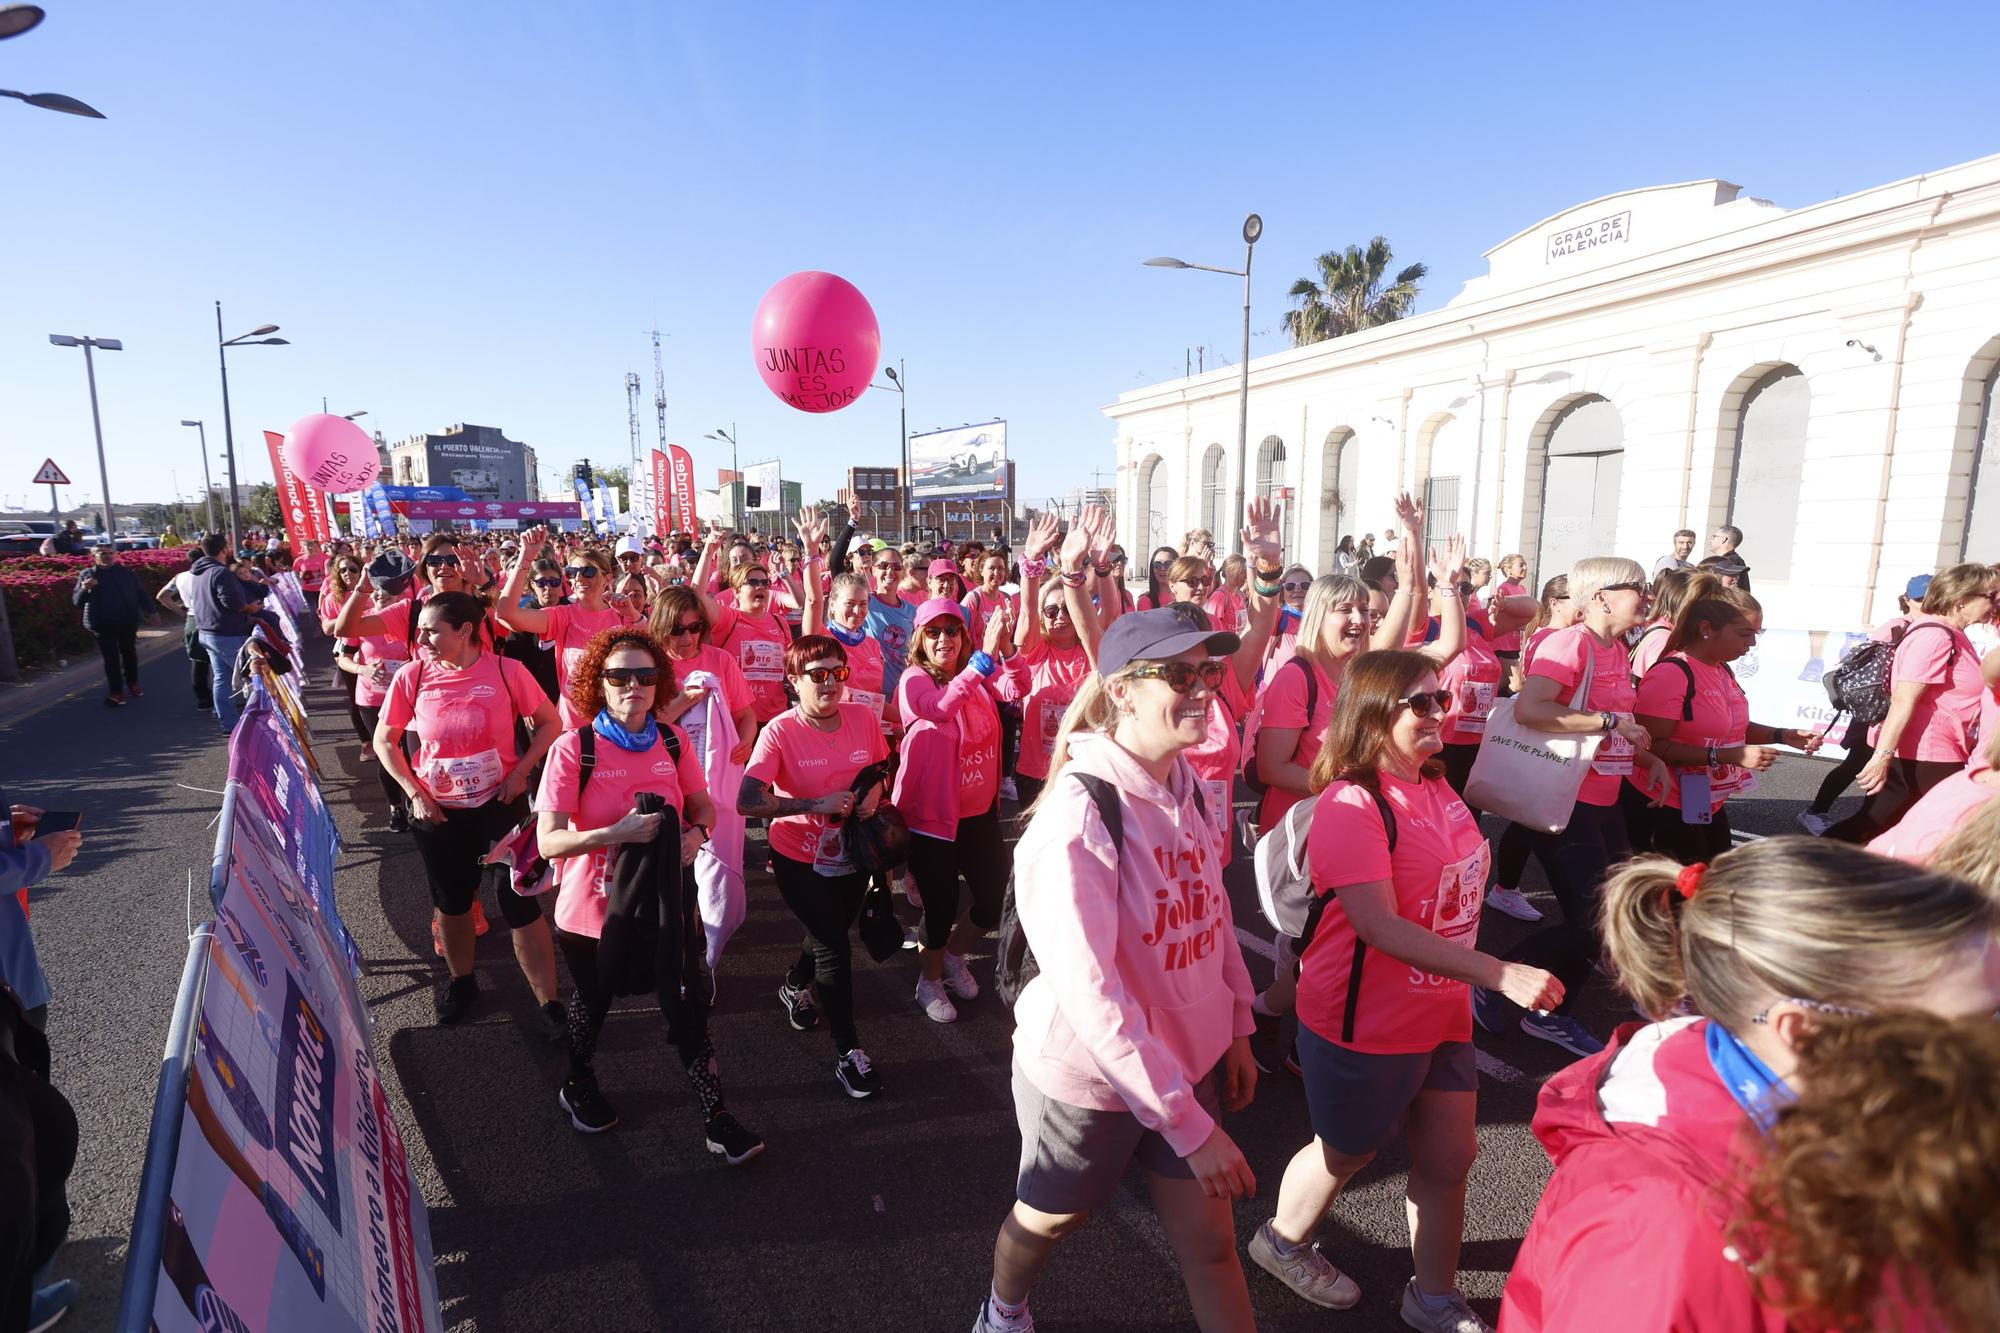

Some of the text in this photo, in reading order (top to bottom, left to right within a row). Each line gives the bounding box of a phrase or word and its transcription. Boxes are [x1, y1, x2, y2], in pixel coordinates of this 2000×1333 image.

[1554, 217, 1622, 246] GRAO DE
[1551, 230, 1623, 258] VALENCIA
[763, 347, 845, 374] JUNTAS
[798, 375, 827, 392] ES
[781, 386, 857, 410] MEJOR
[443, 444, 468, 452] PUERTO
[310, 451, 349, 488] JUNTAS
[336, 471, 353, 485] ES
[1490, 735, 1512, 745] SAVE
[1513, 741, 1531, 753] THE
[798, 758, 828, 768] OYSHO
[455, 776, 480, 787] 016
[365, 1169, 382, 1195] a
